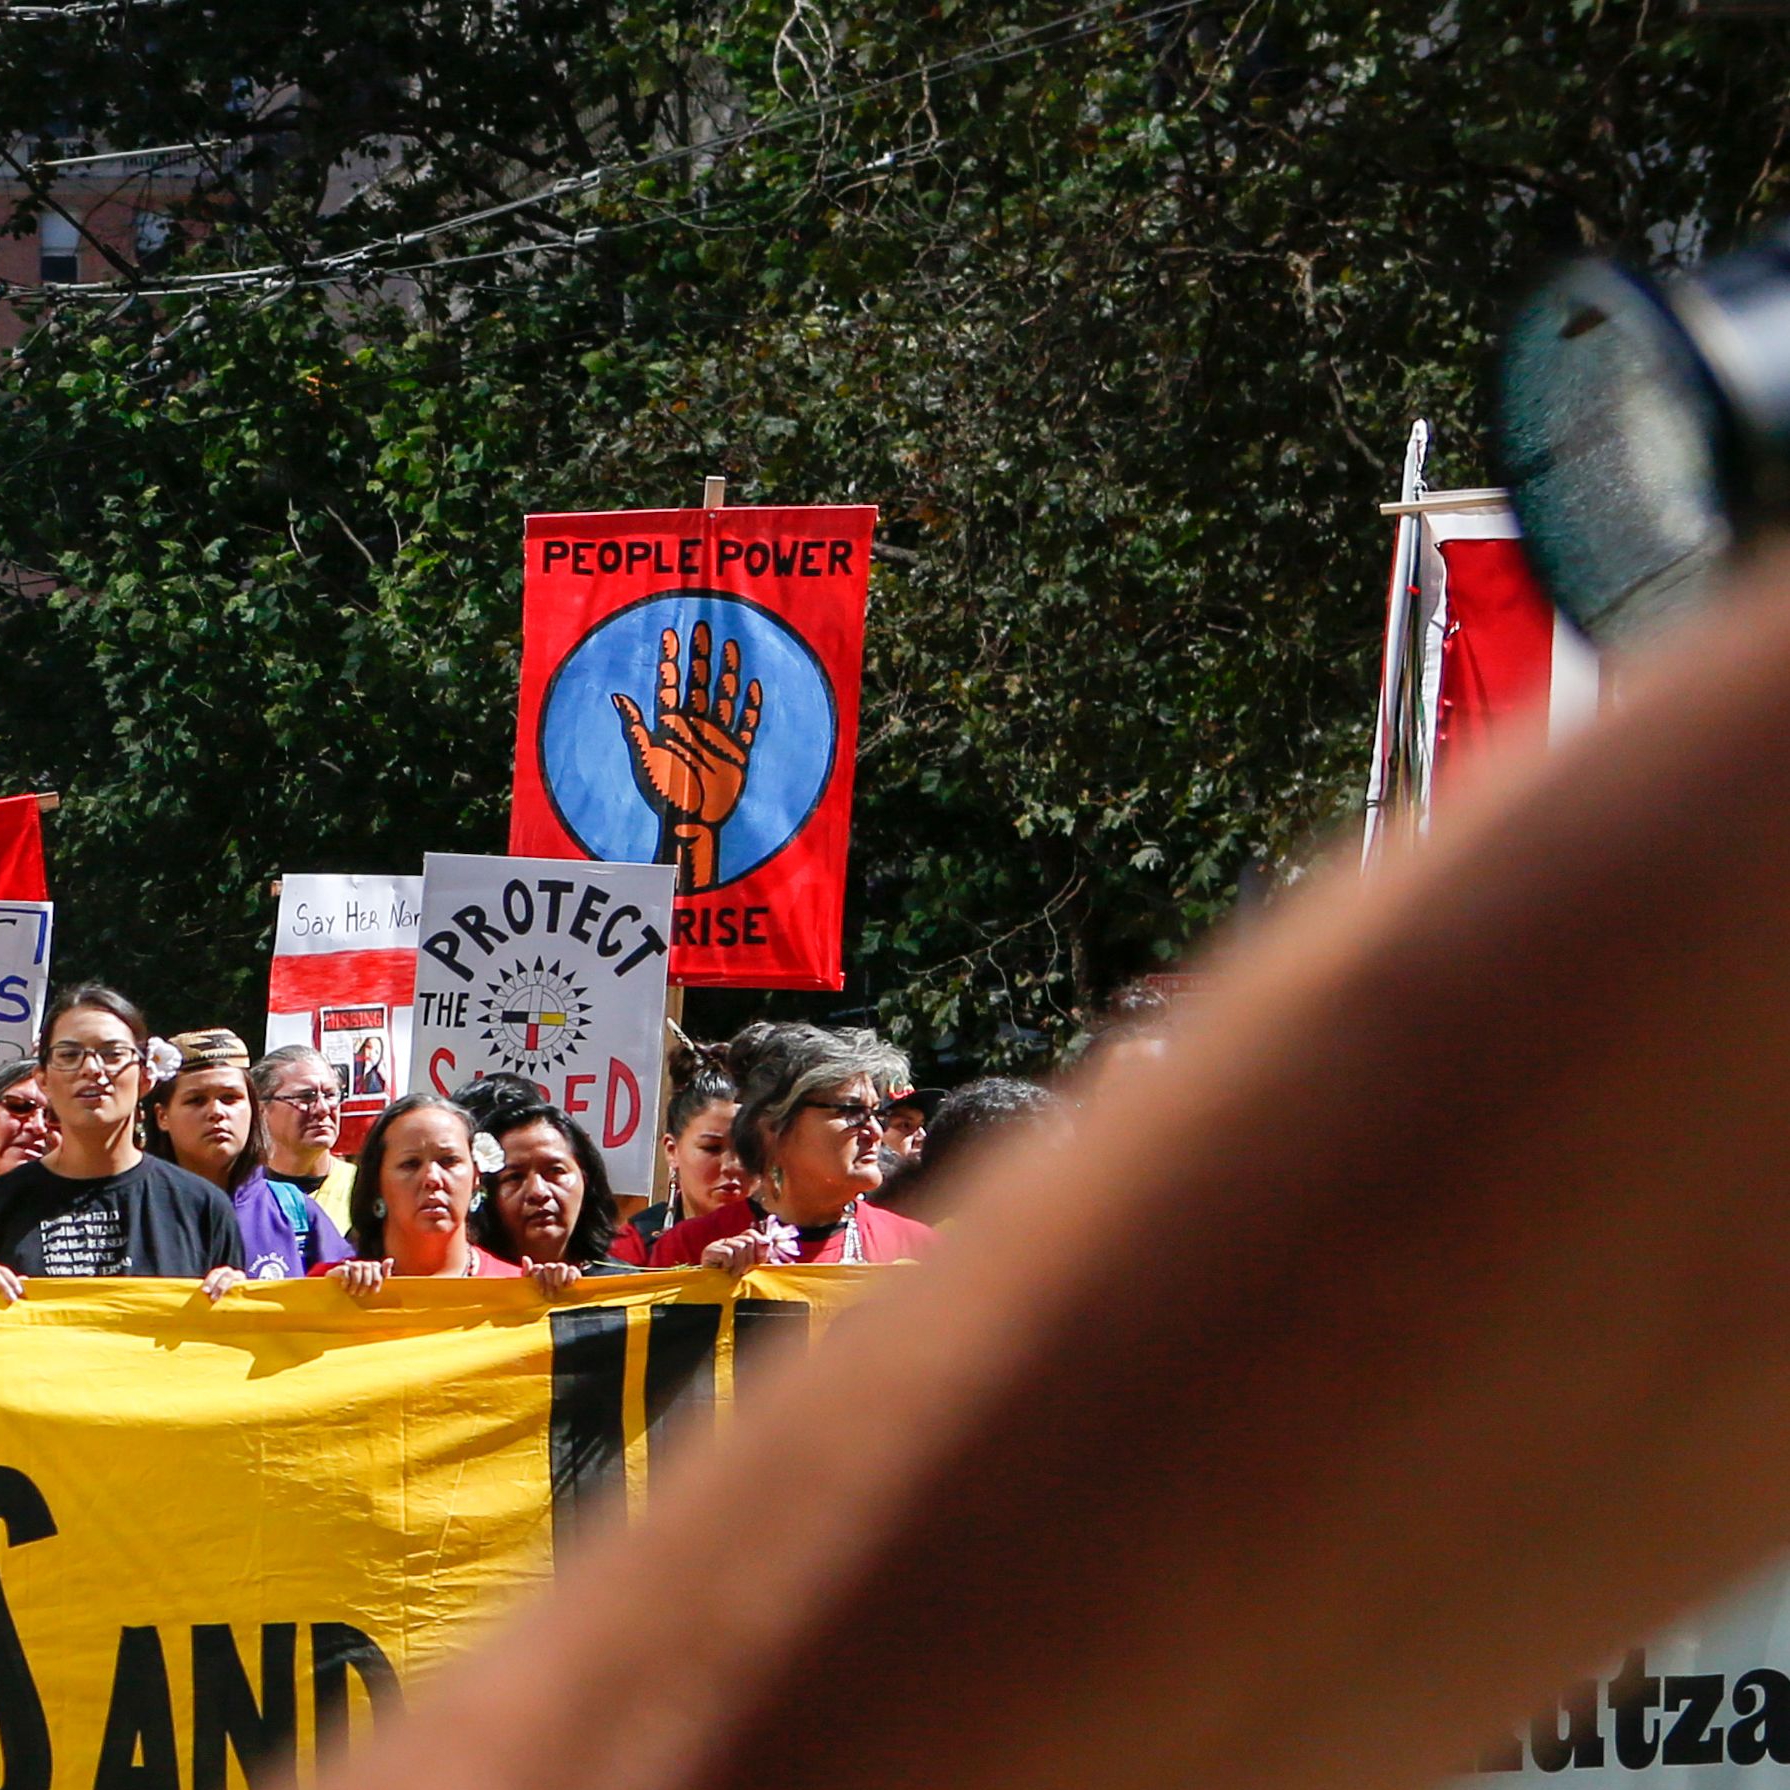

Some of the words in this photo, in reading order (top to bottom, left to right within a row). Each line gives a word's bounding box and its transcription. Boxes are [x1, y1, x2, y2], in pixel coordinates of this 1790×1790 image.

[541, 538, 704, 576] PEOPLE
[715, 539, 853, 577] POWER
[422, 878, 668, 983] PROTECT
[672, 906, 770, 947] RISE
[419, 992, 470, 1029] THE
[428, 1047, 642, 1149] SED
